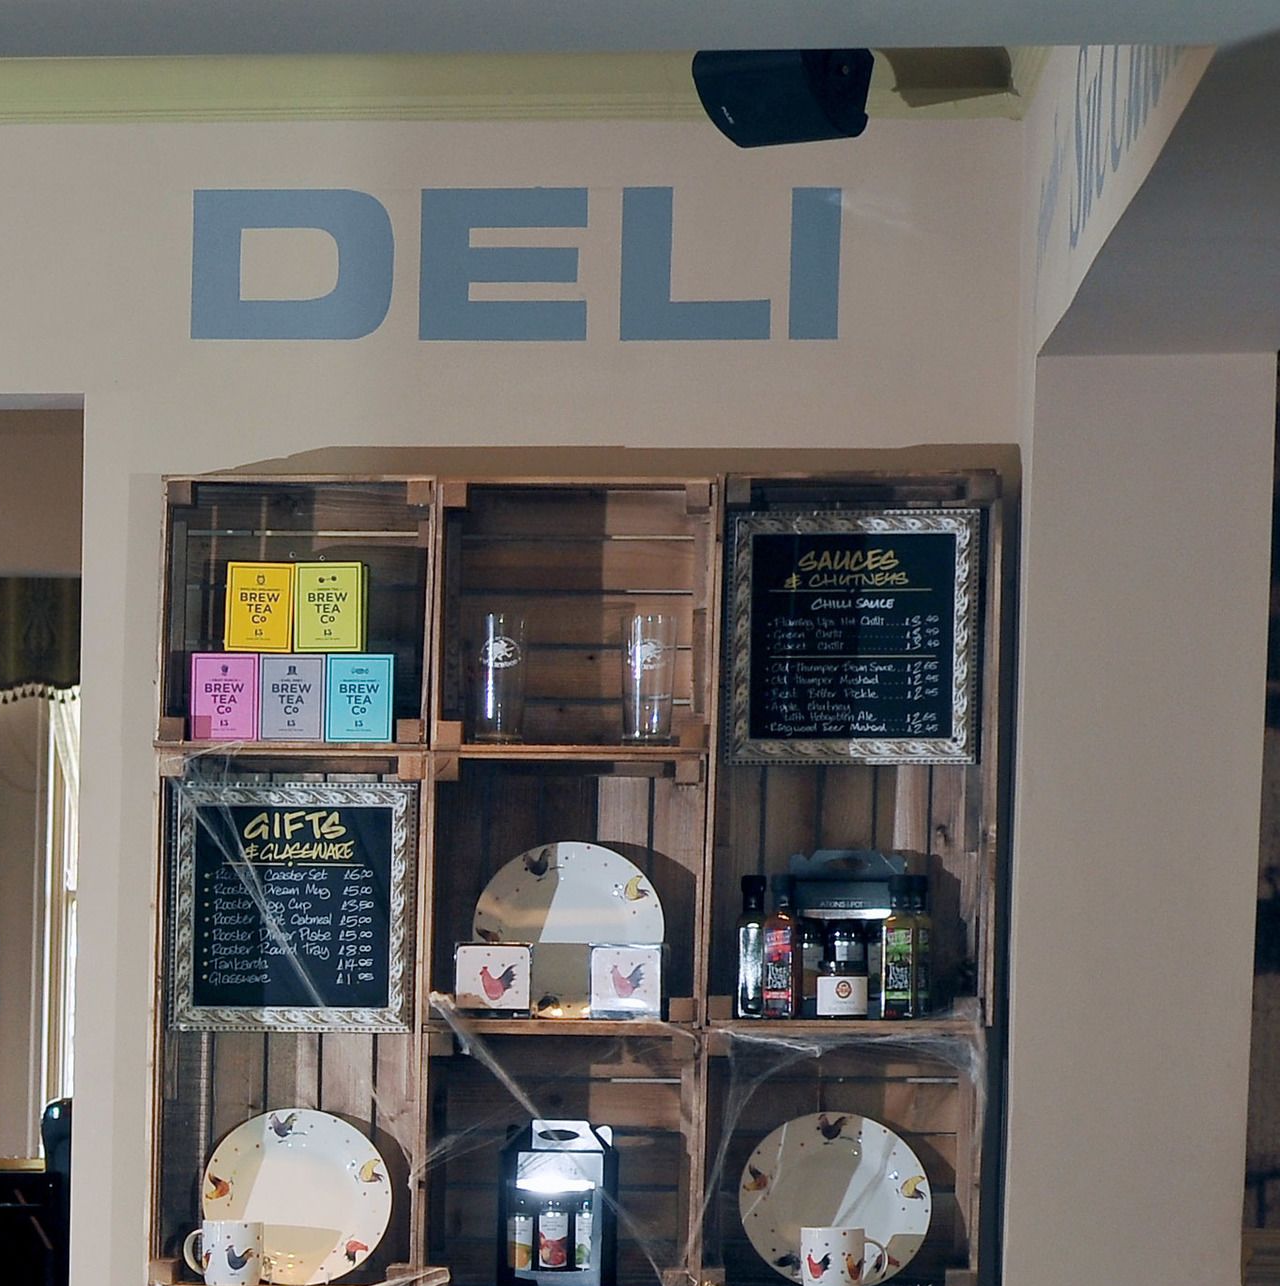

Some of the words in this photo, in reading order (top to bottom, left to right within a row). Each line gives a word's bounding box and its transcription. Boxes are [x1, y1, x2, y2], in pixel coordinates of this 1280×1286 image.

[190, 187, 841, 340] DELI
[798, 549, 900, 571] SAUCES
[808, 571, 909, 587] CHUTNEYS
[240, 592, 280, 603] BREW
[307, 592, 348, 603] BREW
[246, 604, 273, 614] TEA
[314, 604, 341, 614] TEA
[811, 598, 852, 610] CHILLI
[855, 598, 895, 609] SAUCE
[251, 614, 267, 624] Co
[320, 614, 335, 624] Co
[204, 683, 244, 693] BREW
[271, 683, 311, 693] BREW
[339, 683, 379, 693] BREW
[211, 695, 237, 705] TEA
[278, 695, 304, 705] TEA
[346, 695, 372, 705] TEA
[216, 705, 232, 715] Co
[284, 705, 299, 715] Co
[351, 705, 367, 715] Co
[243, 811, 346, 839] GIFTS
[259, 841, 355, 860] GLASSWARE
[308, 869, 328, 880] Set
[213, 883, 252, 895] Rooste
[263, 883, 299, 897] Dream
[306, 884, 331, 899] Mug
[343, 886, 372, 896] £5.00
[213, 898, 254, 911] Rooster
[288, 900, 312, 913] Cup
[212, 912, 255, 925] Rooster
[290, 913, 332, 926] Oatmeal
[339, 916, 372, 927] £5.00
[212, 928, 254, 941] Rooster
[259, 928, 297, 942] Dier
[299, 928, 332, 941] Plate
[339, 931, 373, 941] £5.00
[211, 943, 253, 956] Rooster
[302, 944, 330, 960] Tray
[208, 972, 271, 986] Glassware
